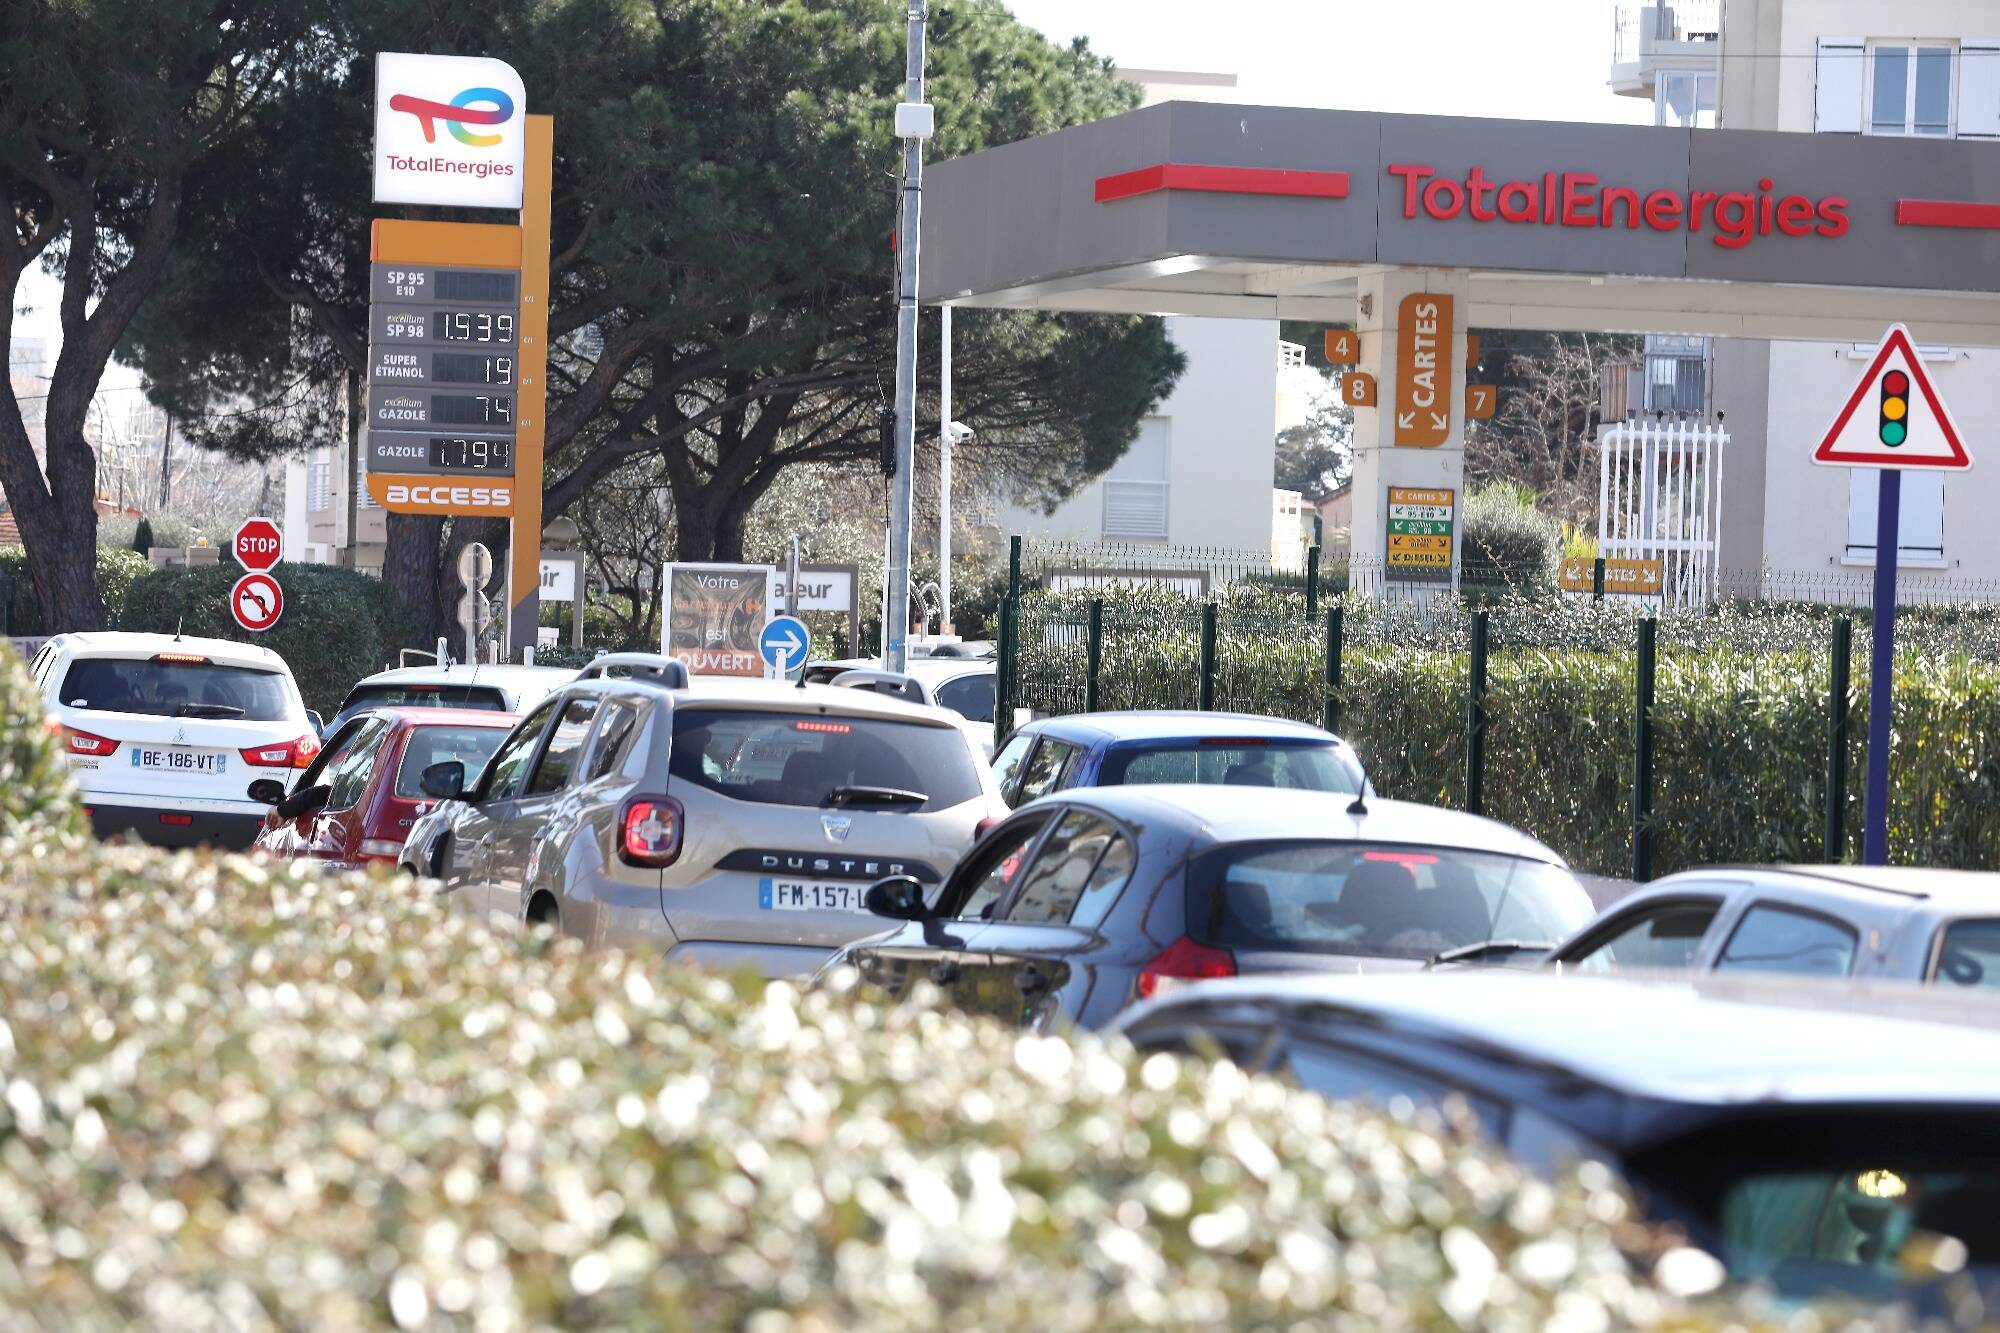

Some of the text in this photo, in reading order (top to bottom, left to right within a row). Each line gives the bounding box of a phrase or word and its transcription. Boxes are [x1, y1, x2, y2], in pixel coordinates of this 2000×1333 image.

[387, 156, 513, 178] TotalEnergies
[1388, 164, 1850, 249] TotalEnergies
[387, 271, 425, 285] SP 95
[396, 285, 415, 296] E10
[387, 314, 425, 324] excellium
[445, 313, 513, 342] 1.939
[387, 324, 424, 337] SP 98
[1335, 336, 1349, 357] 4
[1412, 303, 1438, 408] CARTES
[383, 354, 417, 365] SUPER
[375, 364, 425, 378] ÉTHANOL
[485, 357, 512, 384] 19
[1352, 379, 1366, 400] 8
[384, 397, 422, 407] excellium
[476, 396, 510, 422] 74
[1473, 391, 1487, 412] 7
[379, 408, 426, 420] GAZOLE
[377, 446, 425, 457] GAZOLE
[441, 440, 509, 468] 1.794
[240, 537, 278, 553] STOP
[539, 565, 560, 587] ir
[698, 574, 739, 589] Votre
[706, 628, 728, 641] est
[677, 652, 756, 671] OUVERT
[143, 751, 215, 770] BE-186-VT
[762, 855, 905, 876] DUSTER
[778, 884, 868, 909] FM-157-L
